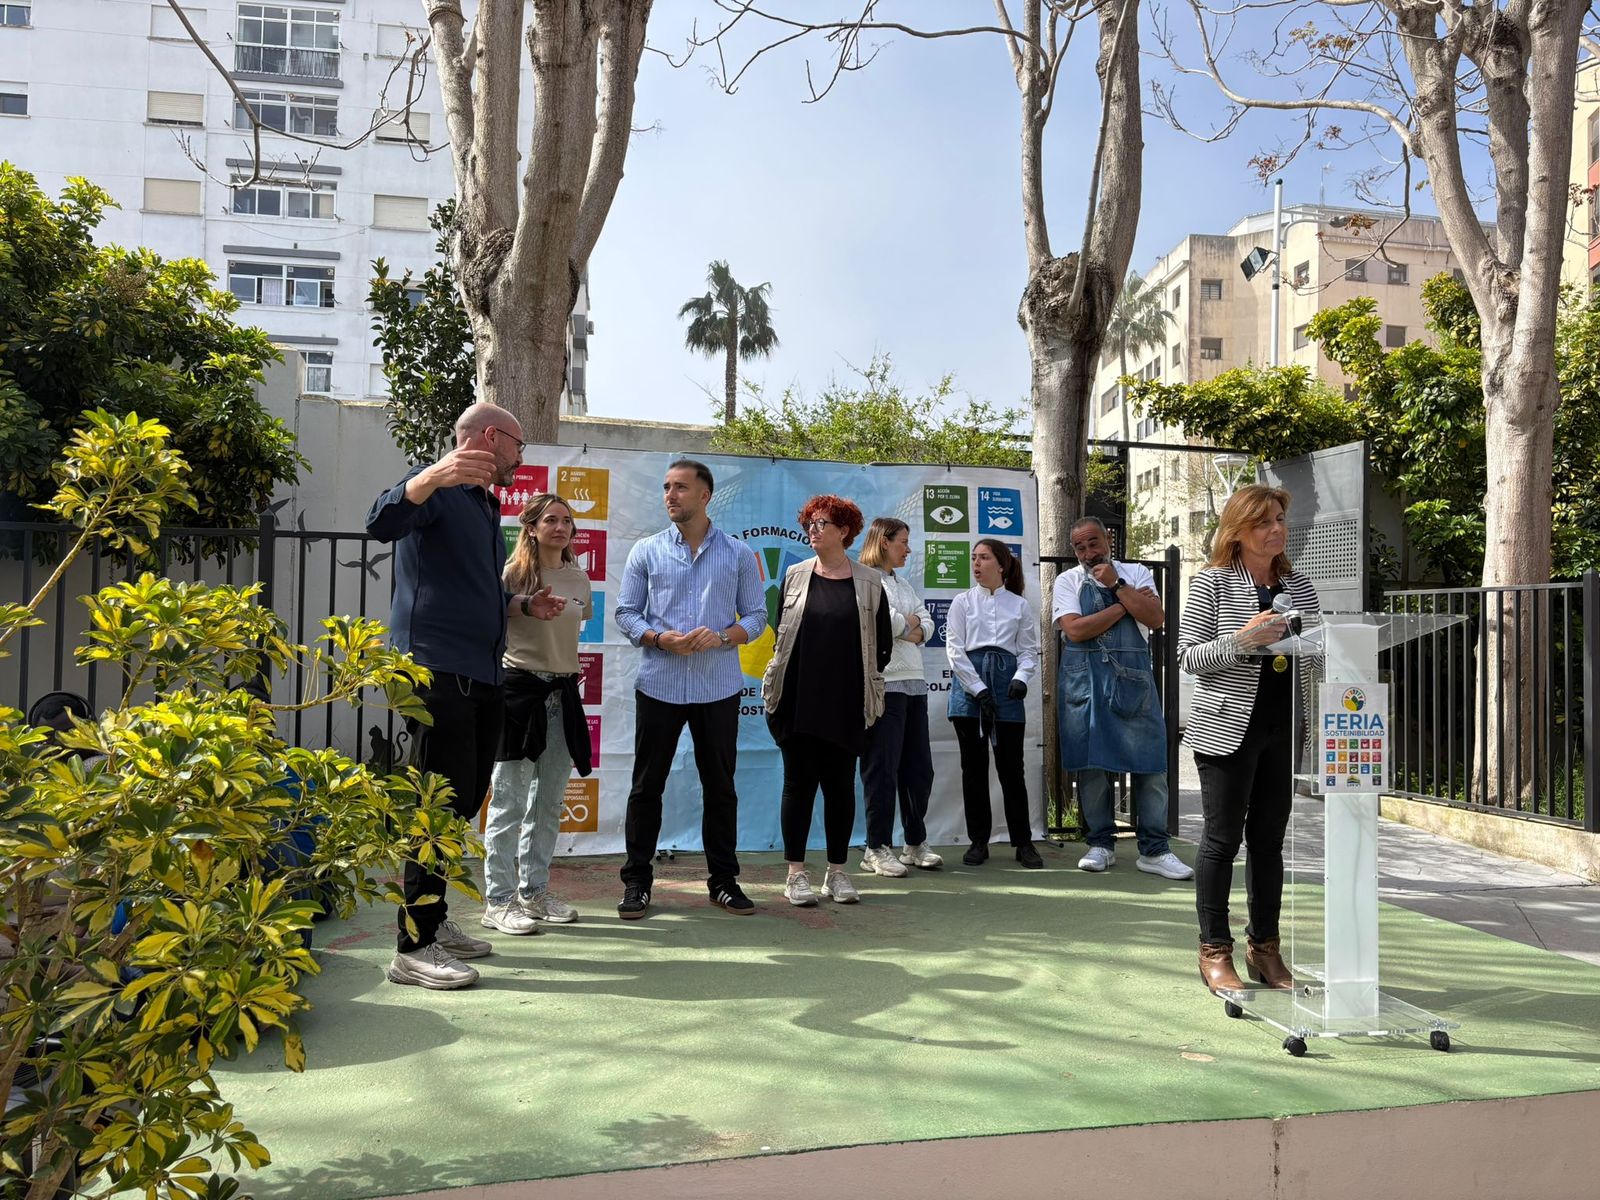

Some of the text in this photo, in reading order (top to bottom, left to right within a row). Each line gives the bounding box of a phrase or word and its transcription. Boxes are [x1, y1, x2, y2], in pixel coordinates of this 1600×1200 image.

[561, 470, 568, 481] 2
[926, 488, 935, 499] 13
[980, 490, 990, 501] 14
[742, 526, 812, 548] FORMACIO
[928, 544, 936, 554] 15
[928, 603, 936, 614] 17
[741, 688, 756, 697] DE
[1324, 714, 1384, 730] FERIA
